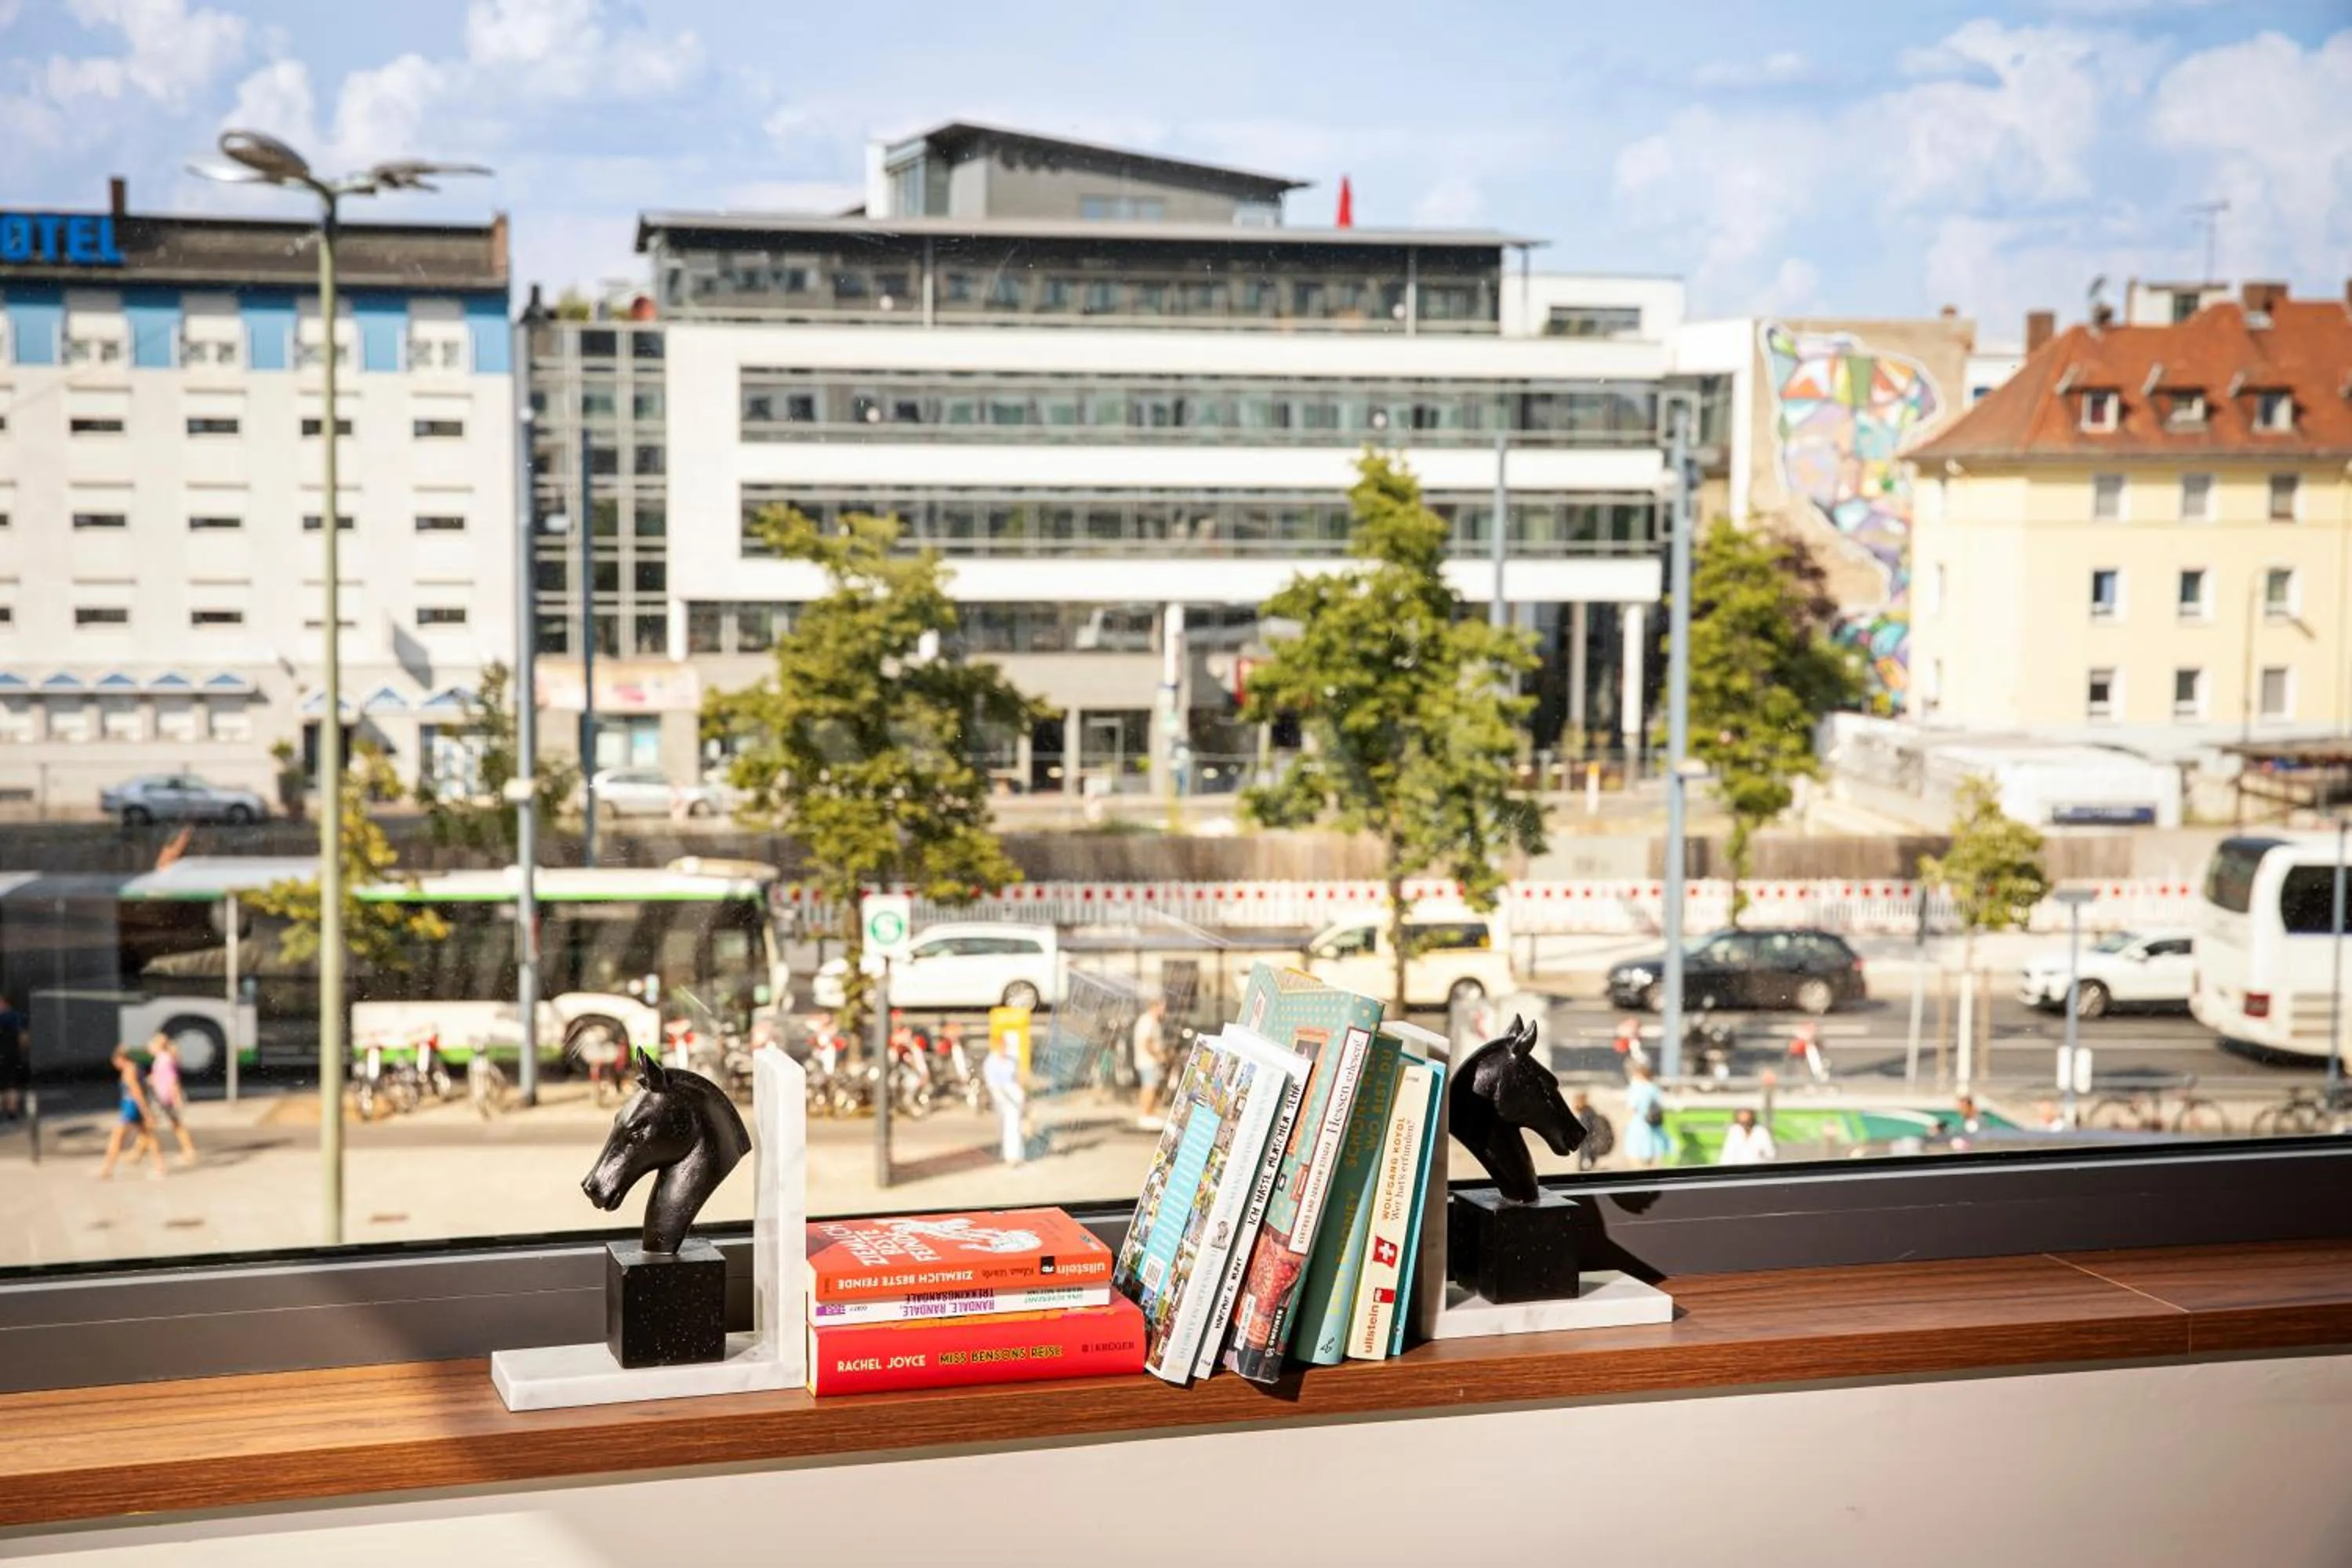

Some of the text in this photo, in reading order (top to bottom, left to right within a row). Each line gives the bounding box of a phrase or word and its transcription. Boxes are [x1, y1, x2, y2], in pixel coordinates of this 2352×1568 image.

[1327, 1086, 1350, 1134] Hessen
[1381, 1156, 1399, 1221] WOLFGANG
[919, 1269, 973, 1283] ZIEMLICH
[1058, 1262, 1105, 1276] ullstein
[837, 1276, 879, 1290] FEINDE
[881, 1274, 915, 1284] BESTE
[1364, 1305, 1379, 1353] ullstein
[837, 1354, 927, 1373] RACHEL JOYCE
[939, 1345, 1062, 1365] MISS BENSONS REISE
